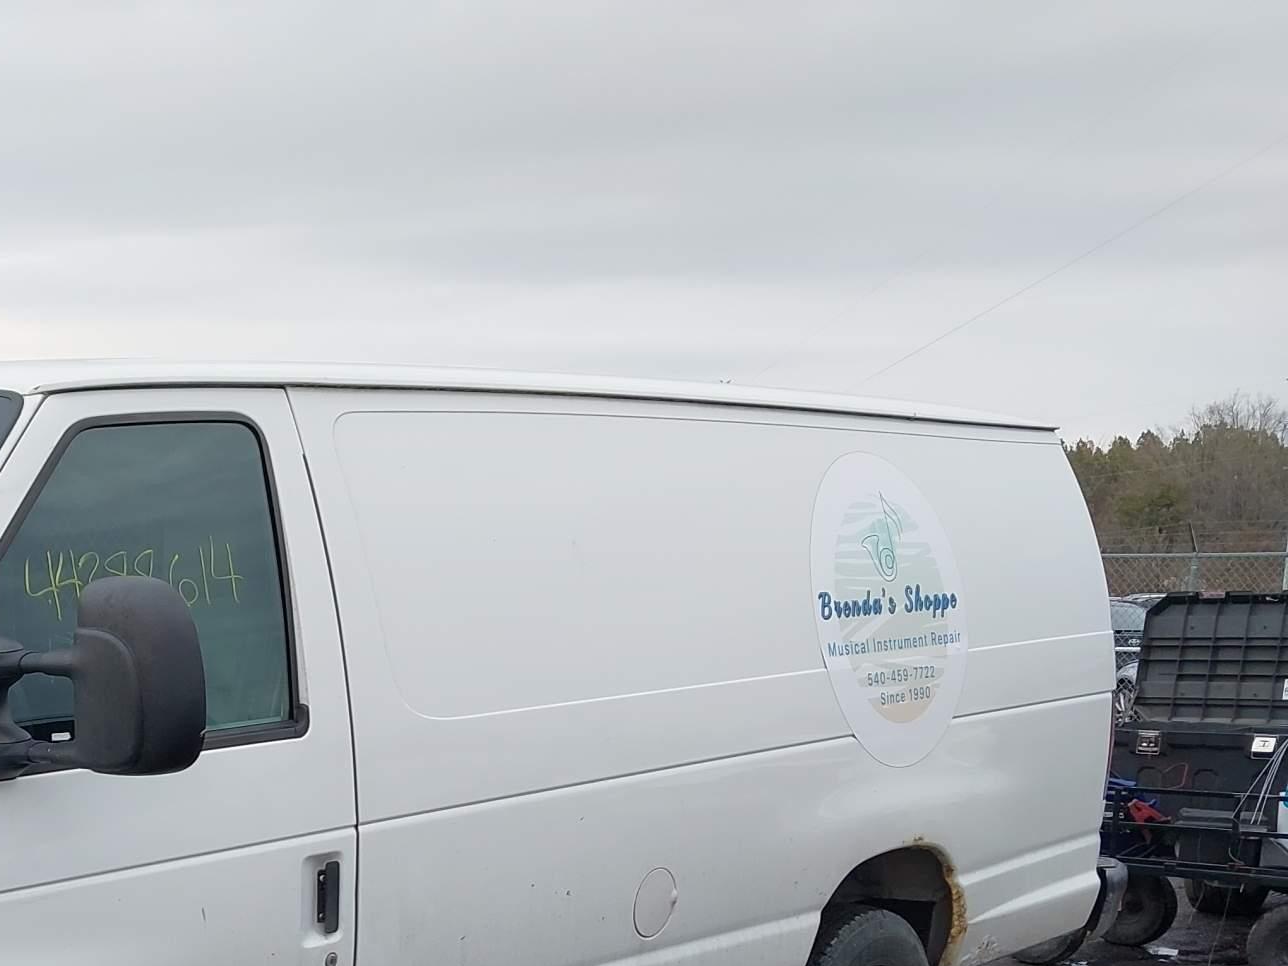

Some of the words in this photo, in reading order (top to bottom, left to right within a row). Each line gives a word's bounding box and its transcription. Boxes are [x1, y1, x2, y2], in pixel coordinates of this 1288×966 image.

[818, 588, 897, 620] Brenda's
[904, 584, 958, 619] Shoppe
[827, 638, 870, 658] Musical
[872, 635, 928, 655] Instrument
[931, 631, 962, 650] Repair
[867, 665, 936, 687] 540-459-7722
[880, 690, 906, 706] Since
[909, 686, 931, 701] 1990
